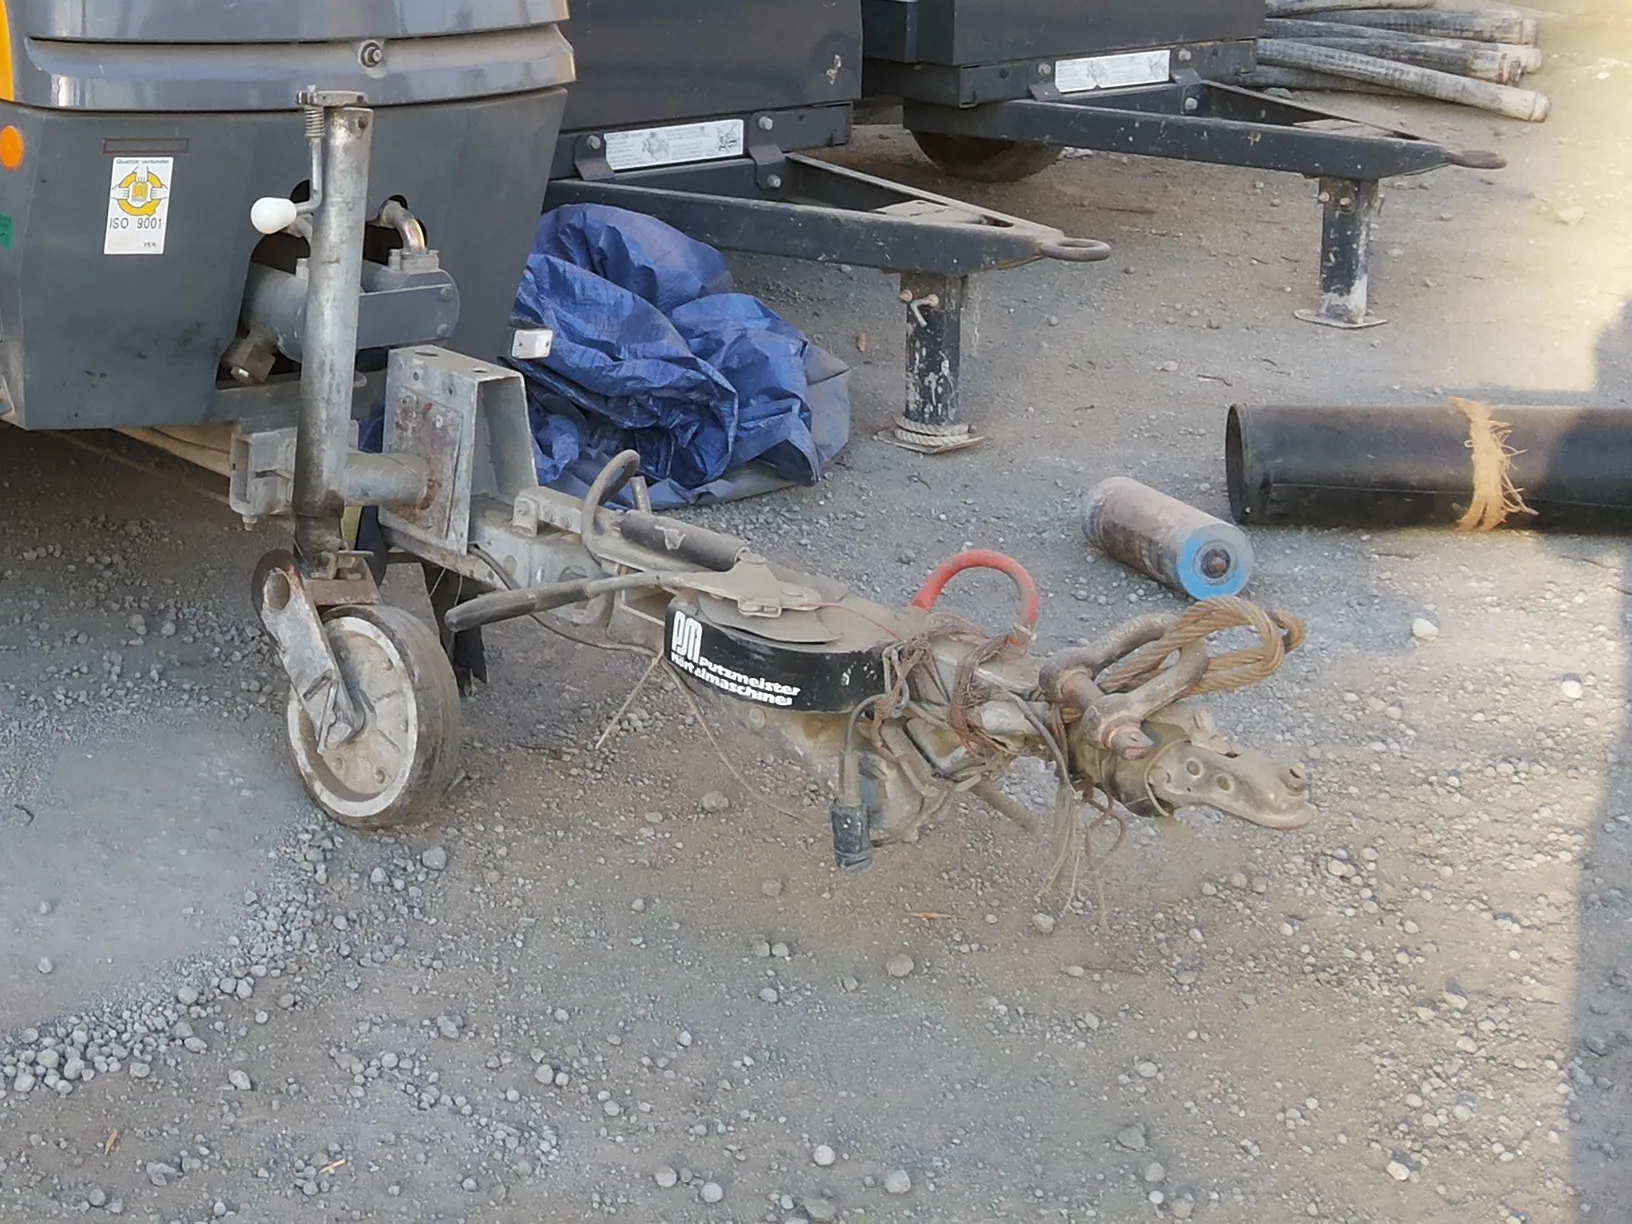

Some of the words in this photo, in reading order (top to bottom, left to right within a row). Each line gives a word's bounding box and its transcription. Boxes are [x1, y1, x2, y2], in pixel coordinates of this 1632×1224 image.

[109, 217, 129, 229] ISO
[137, 217, 162, 229] 9001
[699, 656, 801, 696] Putzmeister
